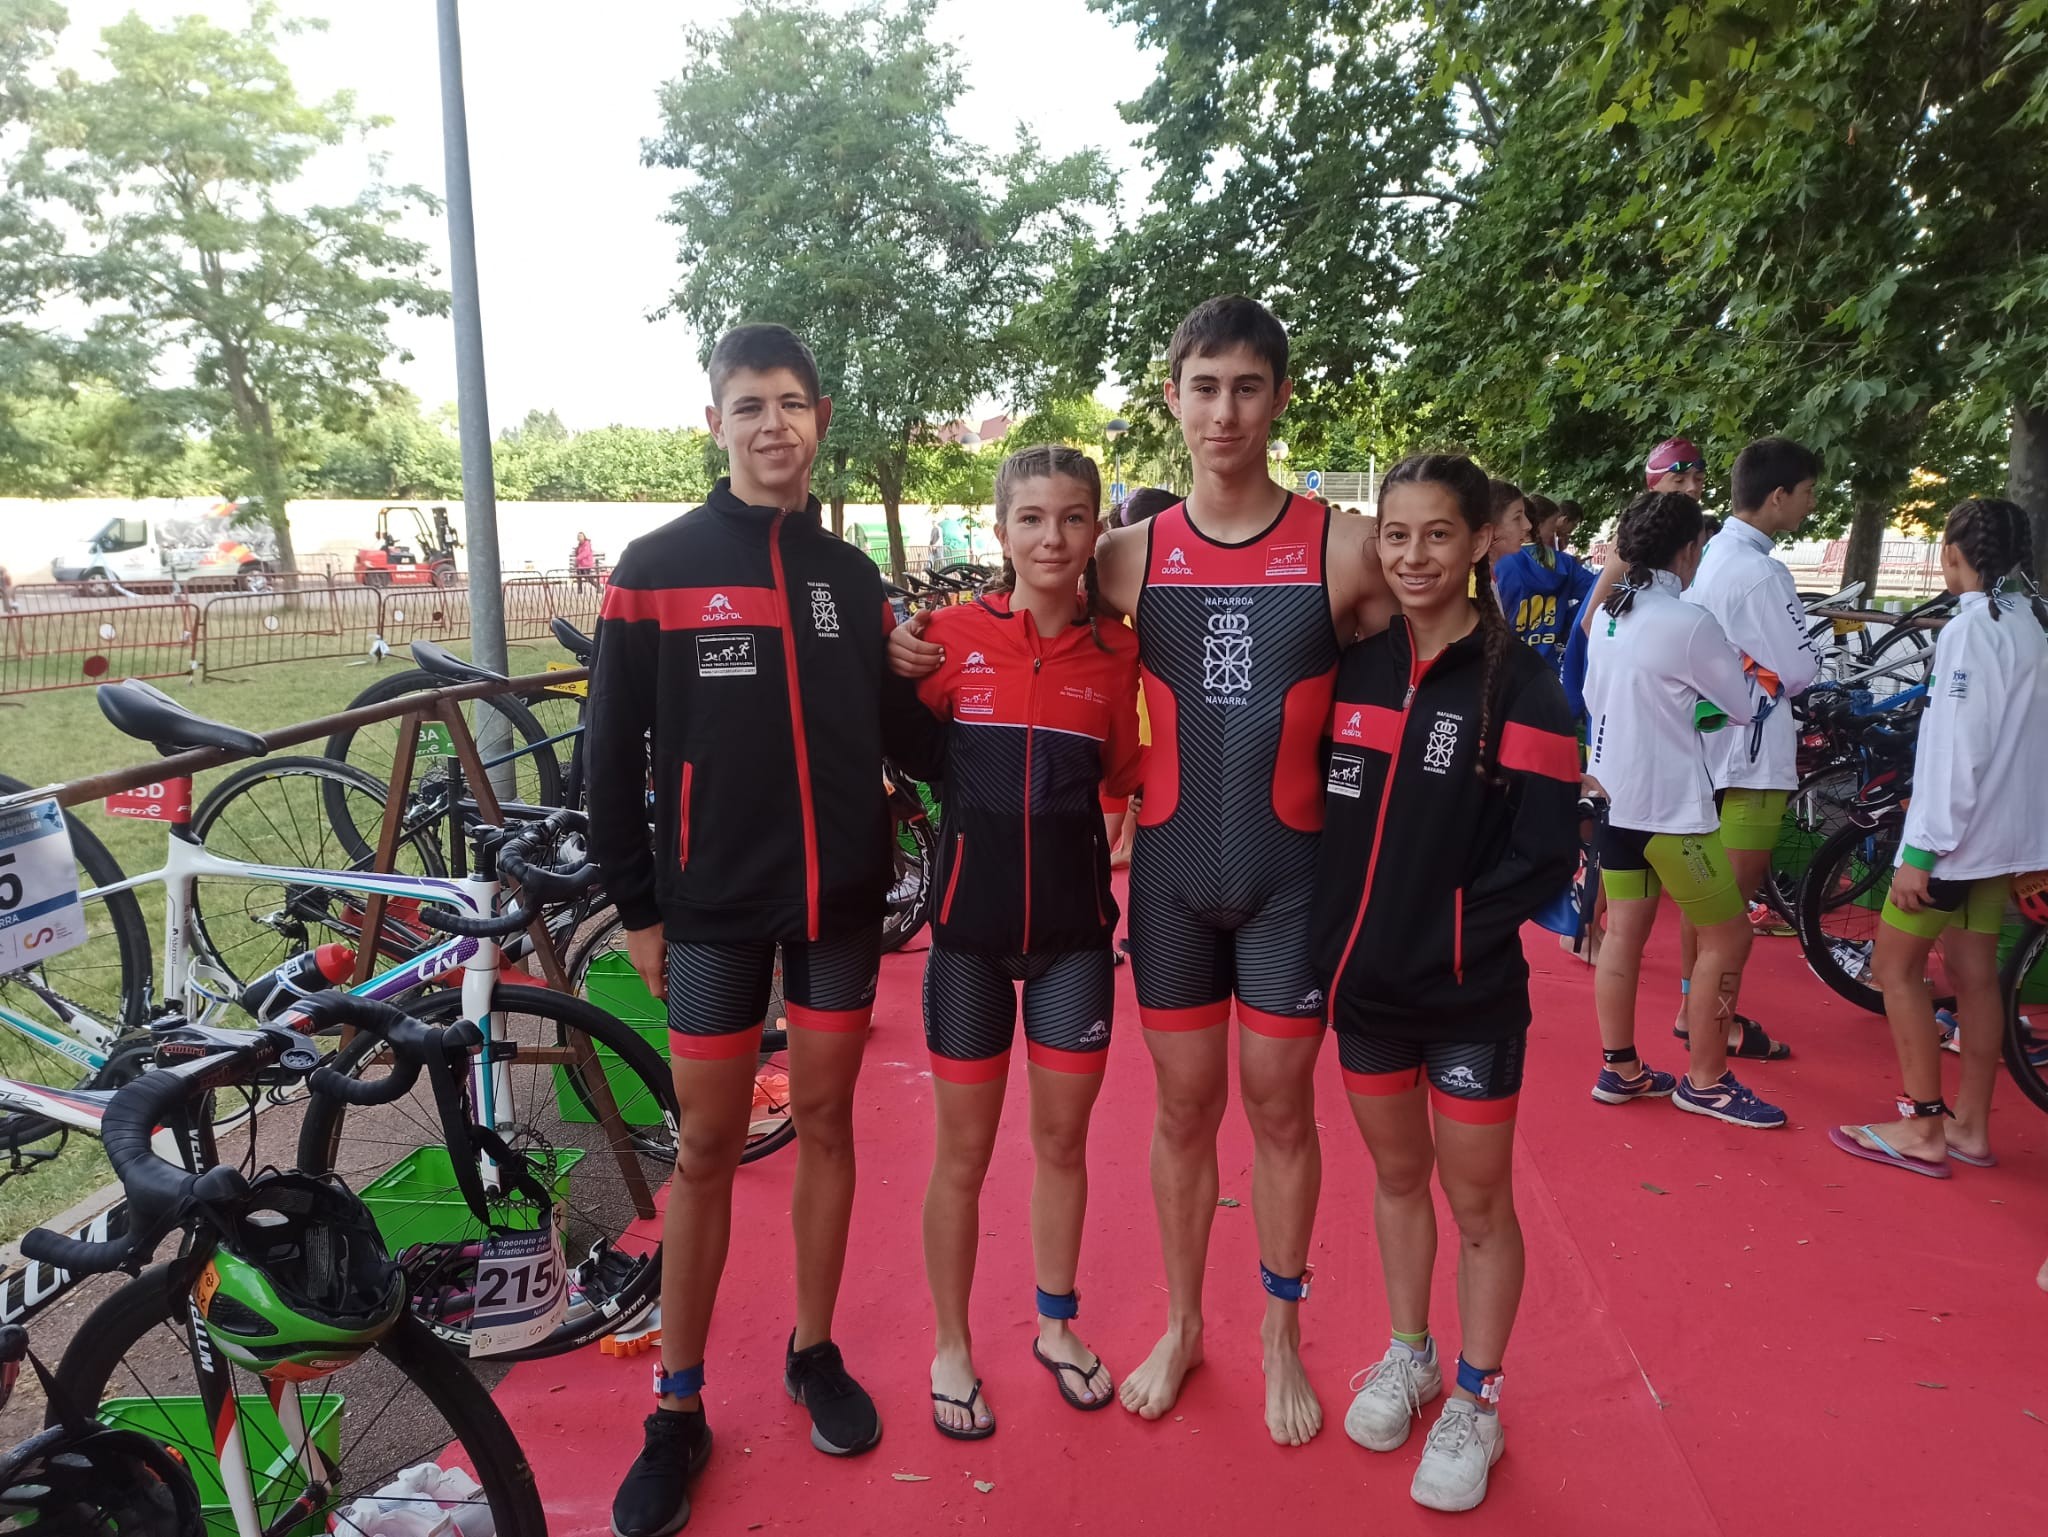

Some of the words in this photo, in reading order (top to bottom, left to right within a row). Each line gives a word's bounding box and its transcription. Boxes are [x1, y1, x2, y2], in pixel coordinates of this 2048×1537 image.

[1204, 596, 1254, 606] NAFARROA
[1205, 695, 1248, 706] NAVARRA
[417, 951, 458, 981] Liv
[56, 1041, 92, 1063] AVAIL
[188, 1128, 204, 1174] VELL
[484, 1248, 495, 1257] de
[497, 1245, 525, 1256] Triatlón
[617, 1293, 647, 1323] GIANT
